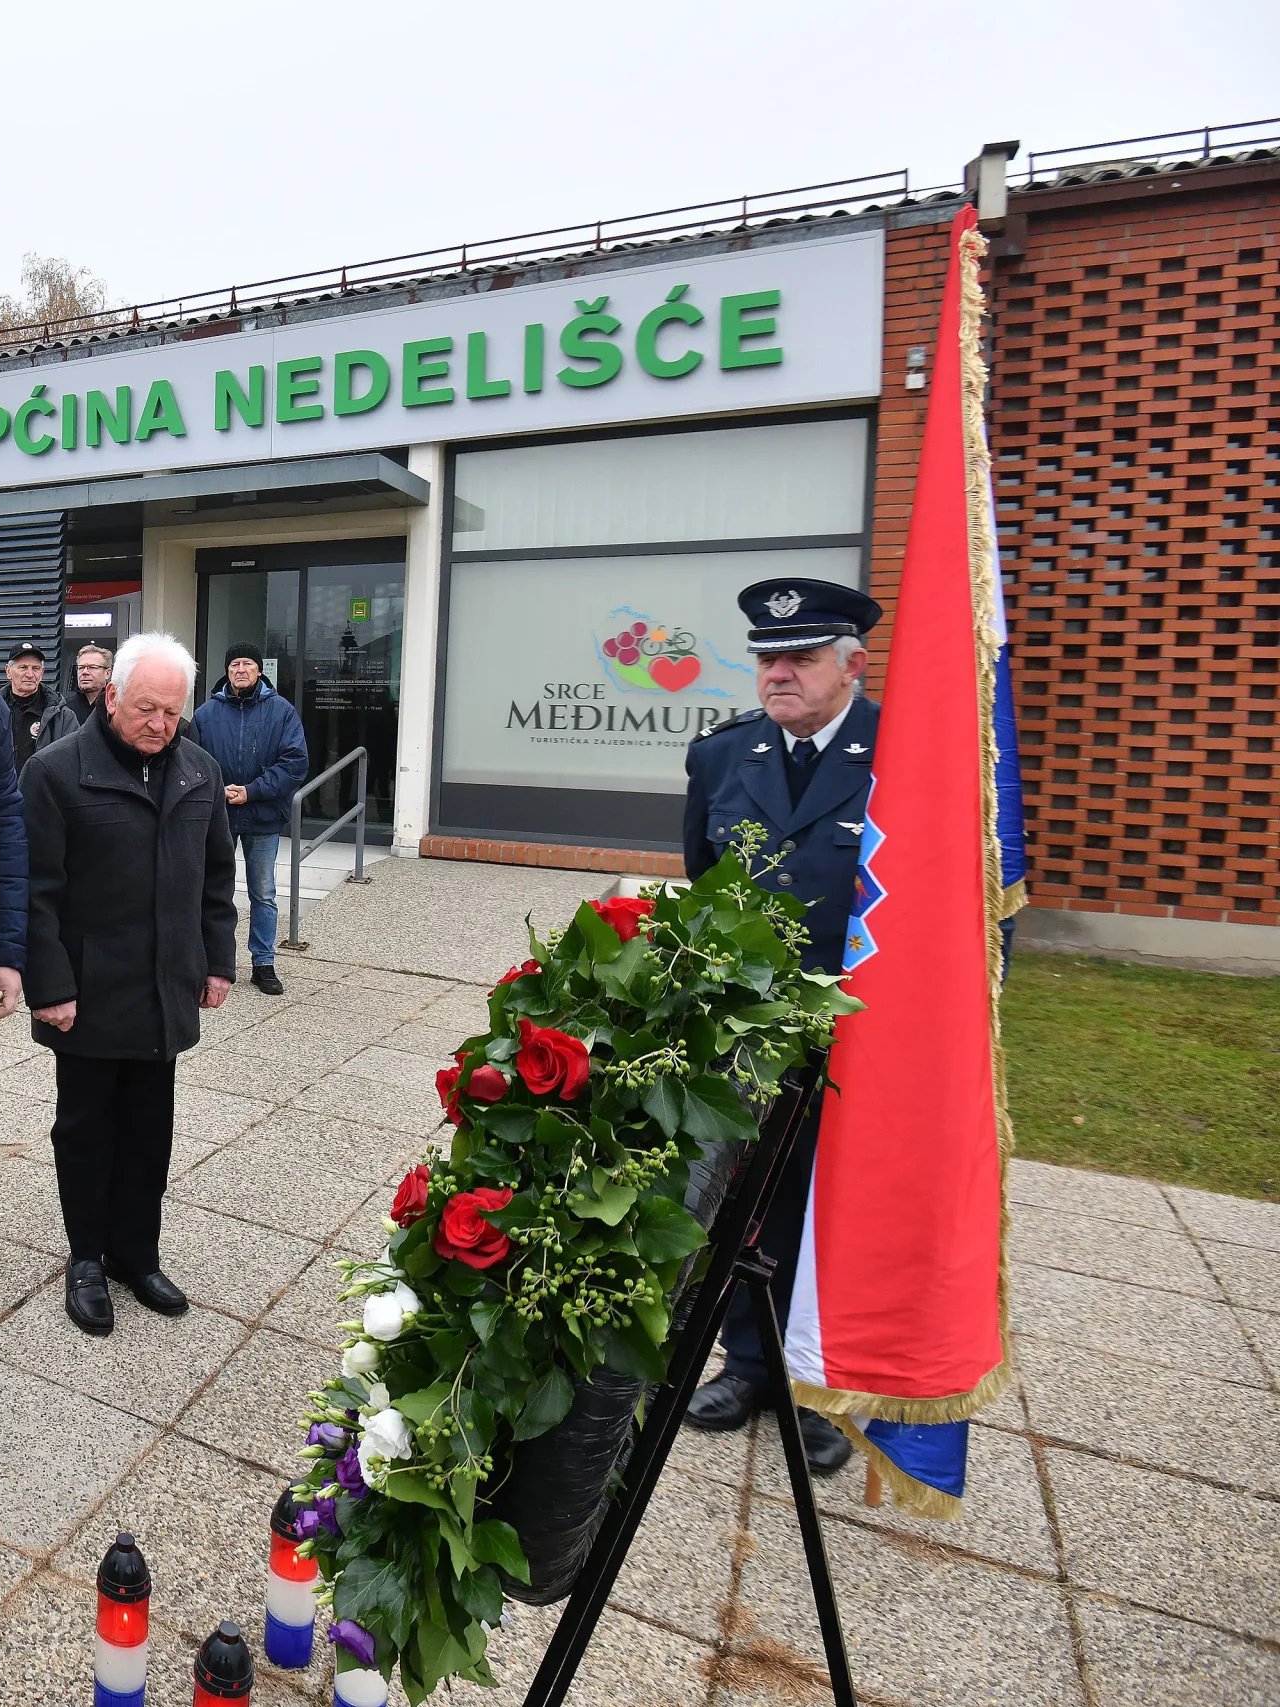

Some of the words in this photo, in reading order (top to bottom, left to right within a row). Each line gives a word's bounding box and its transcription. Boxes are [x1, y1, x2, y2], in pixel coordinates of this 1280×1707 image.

[215, 284, 783, 431] NEDELIŠĆE
[543, 683, 605, 700] SRCE
[505, 700, 740, 733] MEĐIMUR
[530, 736, 589, 745] TURISTIČKA
[593, 738, 652, 747] ZAJEDNICA
[657, 740, 687, 748] PODR
